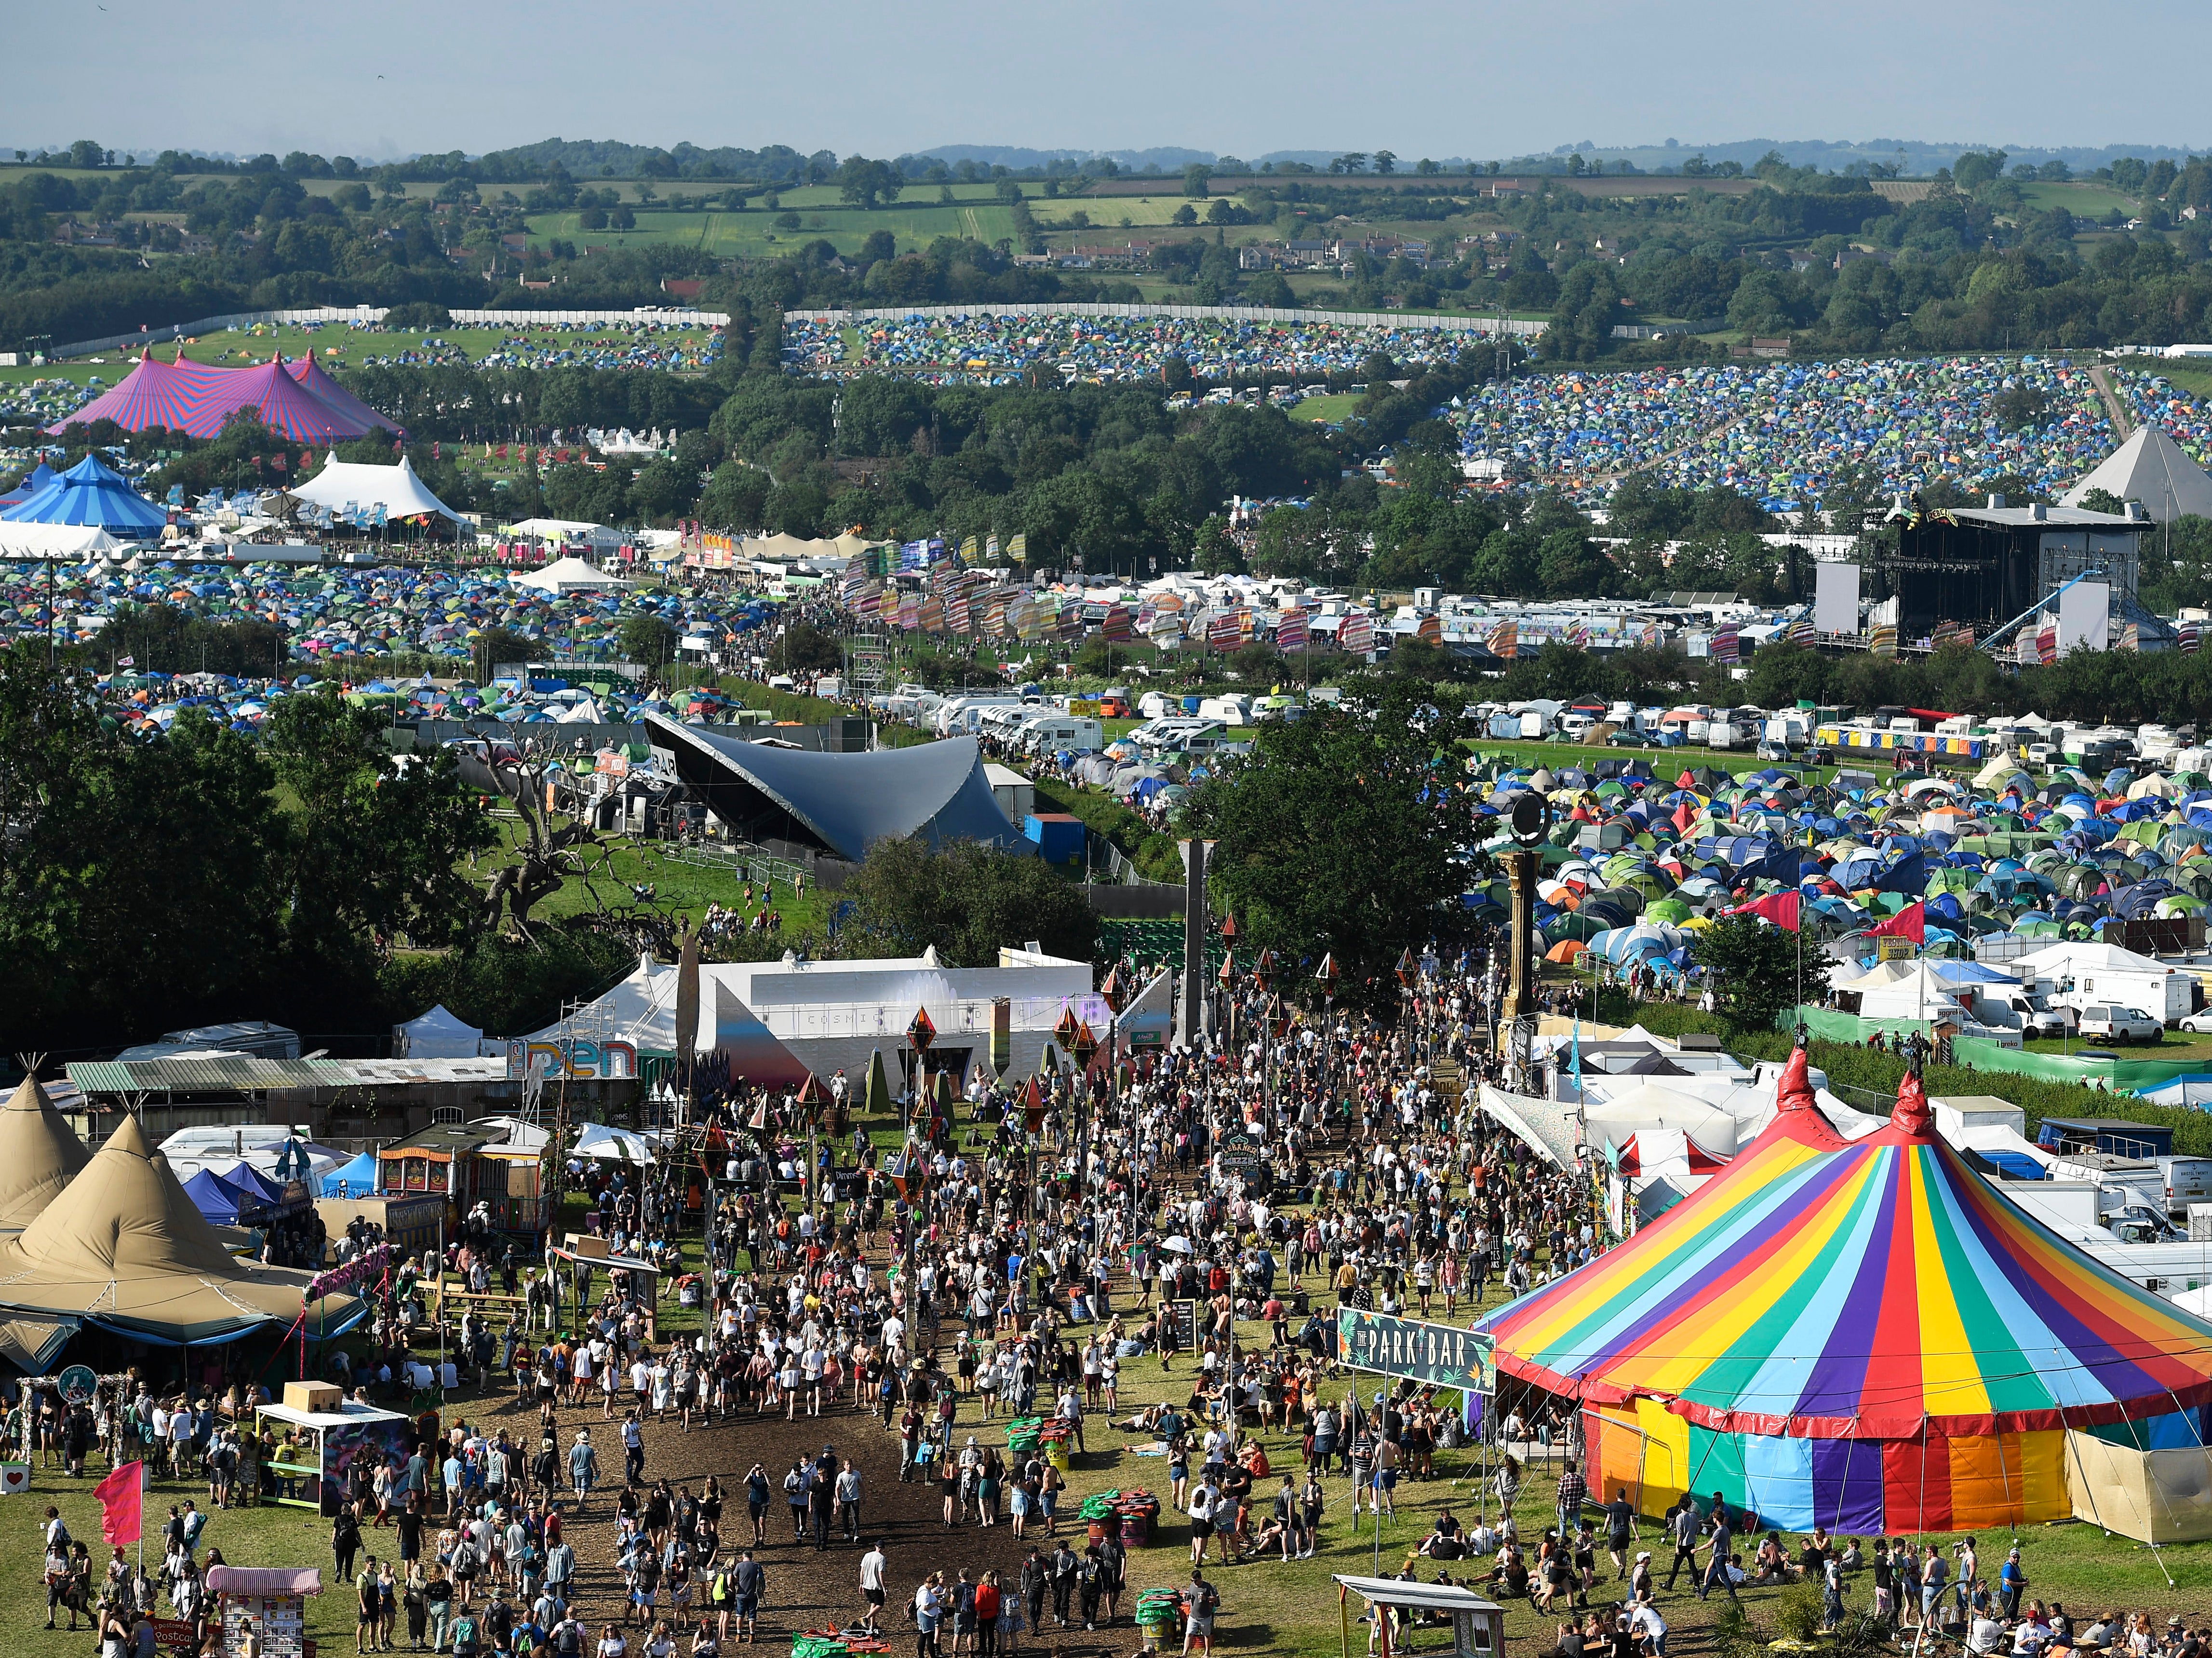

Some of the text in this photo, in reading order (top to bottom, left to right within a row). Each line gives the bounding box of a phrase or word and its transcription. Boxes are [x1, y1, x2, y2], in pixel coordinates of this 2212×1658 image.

[1928, 508, 1958, 526] REBELLION
[611, 759, 623, 771] PIZZA
[652, 752, 676, 777] BAR
[1887, 948, 1909, 959] SHOP
[2001, 1040, 2018, 1049] greko
[1516, 1127, 1537, 1148] MEZZE
[403, 1148, 428, 1157] CIRCUS
[429, 1153, 450, 1161] MUSEUM
[1223, 1144, 1258, 1155] LEBANESE
[1356, 1328, 1465, 1366] THE PARK BAR
[159, 1622, 184, 1631] postcard
[155, 1631, 194, 1642] Postcar
